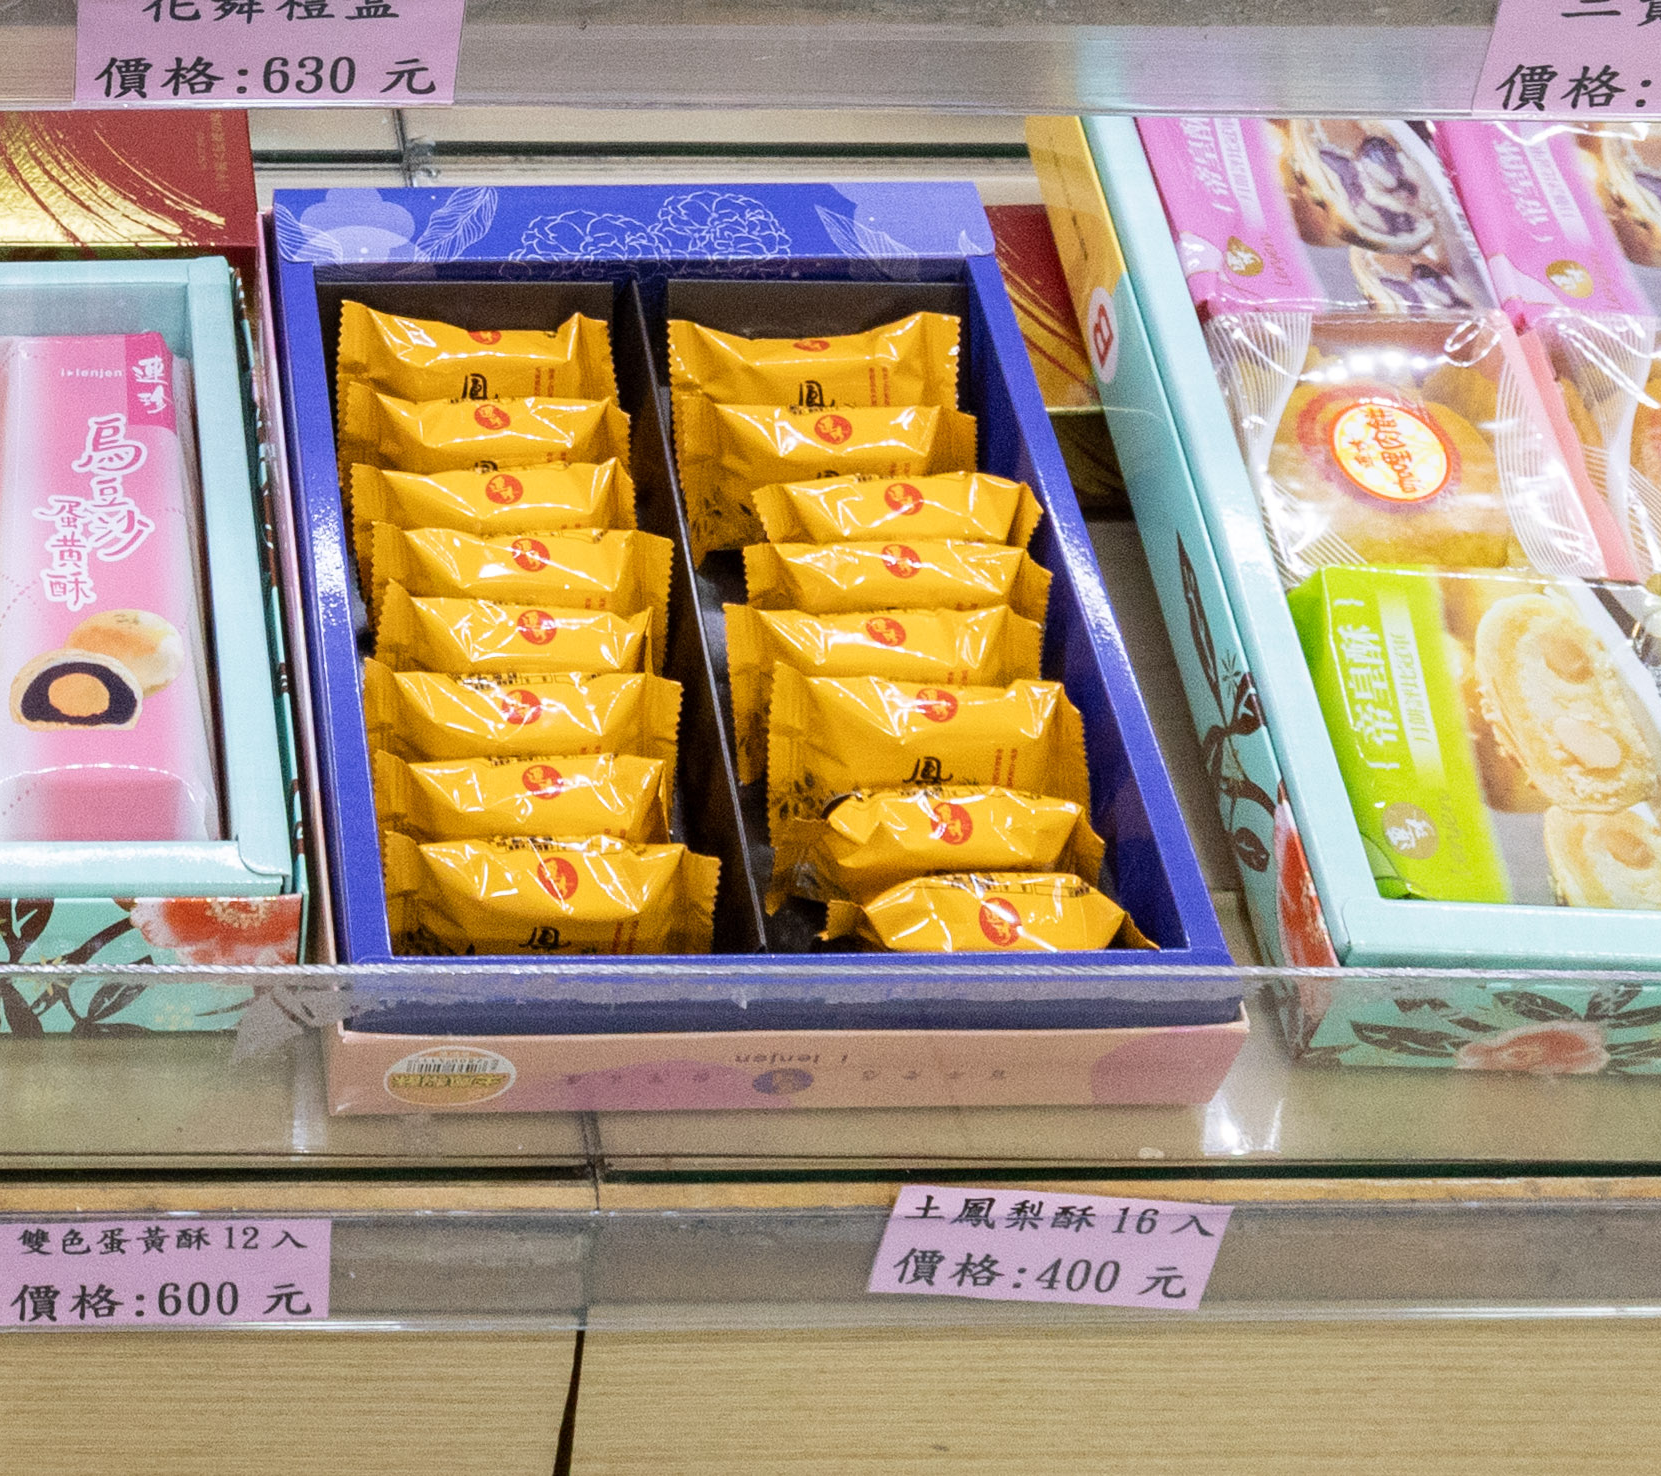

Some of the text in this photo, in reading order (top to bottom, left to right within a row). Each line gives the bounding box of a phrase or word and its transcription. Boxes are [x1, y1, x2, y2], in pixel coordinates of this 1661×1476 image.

[130, 357, 171, 415] 連珍
[72, 413, 156, 563] 烏豆沙
[36, 495, 98, 611] 蛋黃酥
[1341, 621, 1402, 748] 帝皇酥
